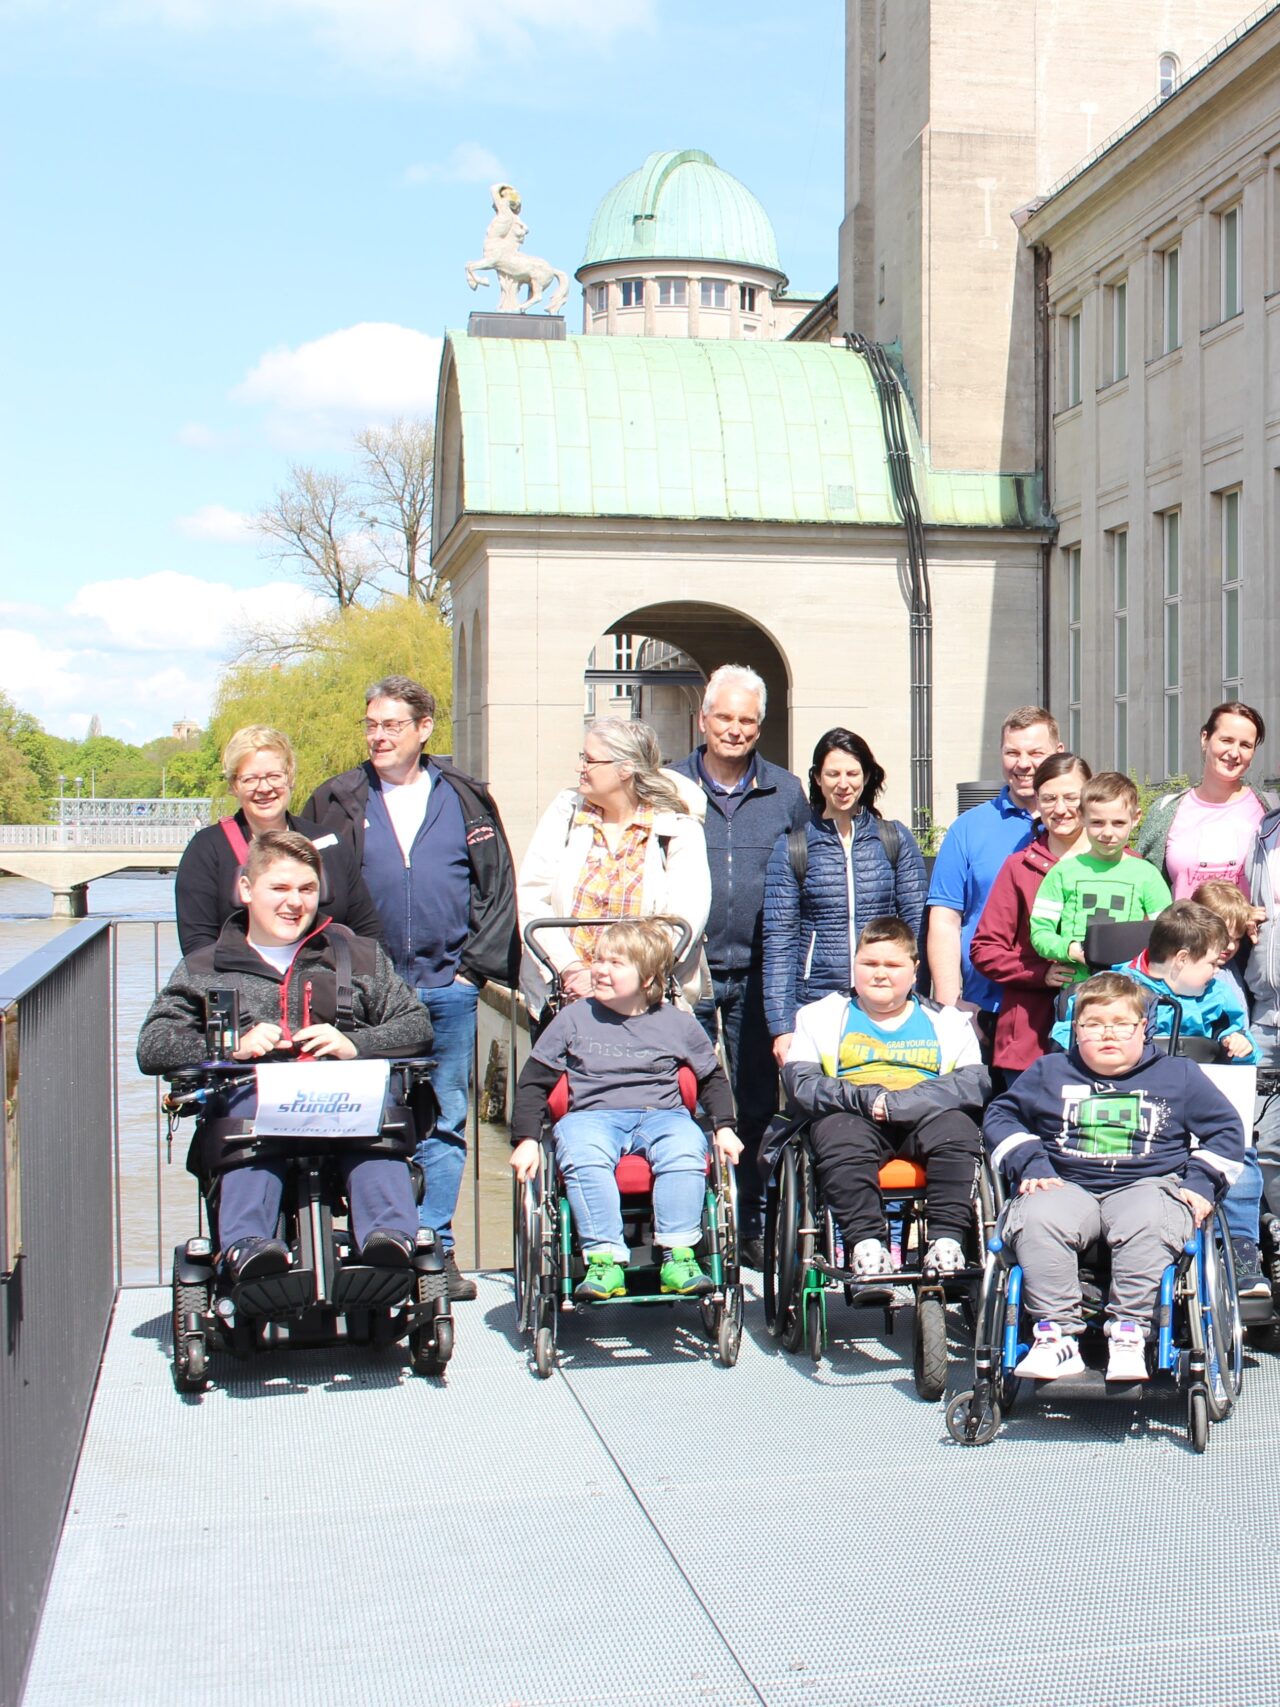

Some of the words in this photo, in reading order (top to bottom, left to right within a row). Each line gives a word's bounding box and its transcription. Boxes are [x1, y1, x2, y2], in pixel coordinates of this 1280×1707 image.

[887, 1040, 905, 1049] GRAB
[905, 1039, 925, 1048] YOUR
[277, 1100, 362, 1113] stunden
